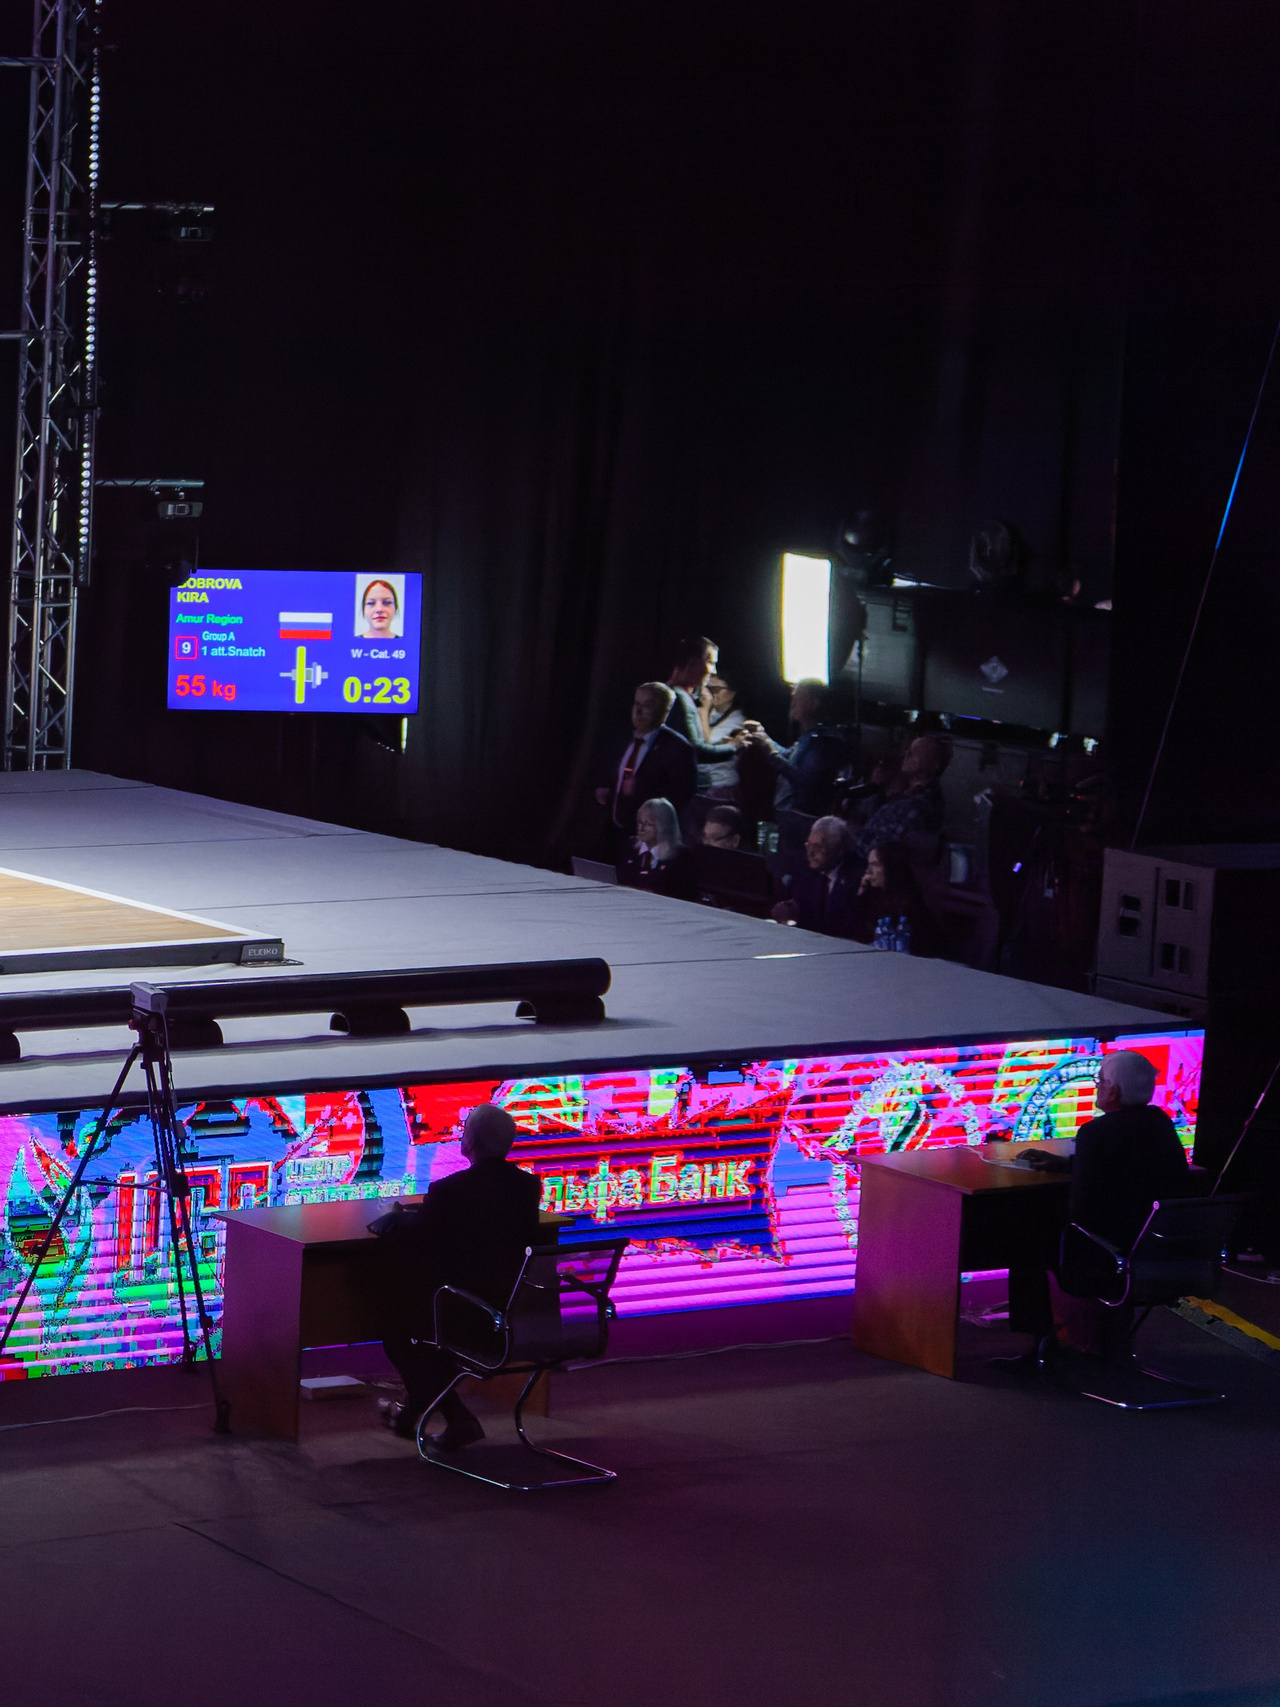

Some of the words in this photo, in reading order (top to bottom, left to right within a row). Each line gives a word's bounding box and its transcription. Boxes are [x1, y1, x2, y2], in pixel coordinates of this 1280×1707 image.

[176, 591, 209, 603] KIRA
[176, 613, 204, 623] Amur
[206, 613, 243, 626] Region
[201, 631, 228, 643] Group
[228, 631, 236, 641] A
[181, 641, 191, 654] 9
[201, 646, 207, 656] 1
[351, 649, 363, 658] W
[370, 649, 390, 659] Cat.
[392, 649, 406, 659] 49
[175, 674, 207, 697] 55
[211, 679, 237, 701] kg
[343, 676, 412, 704] 0:23
[248, 947, 278, 957] ELEIKO
[526, 1155, 644, 1224] льфа
[649, 1151, 754, 1202] Банк
